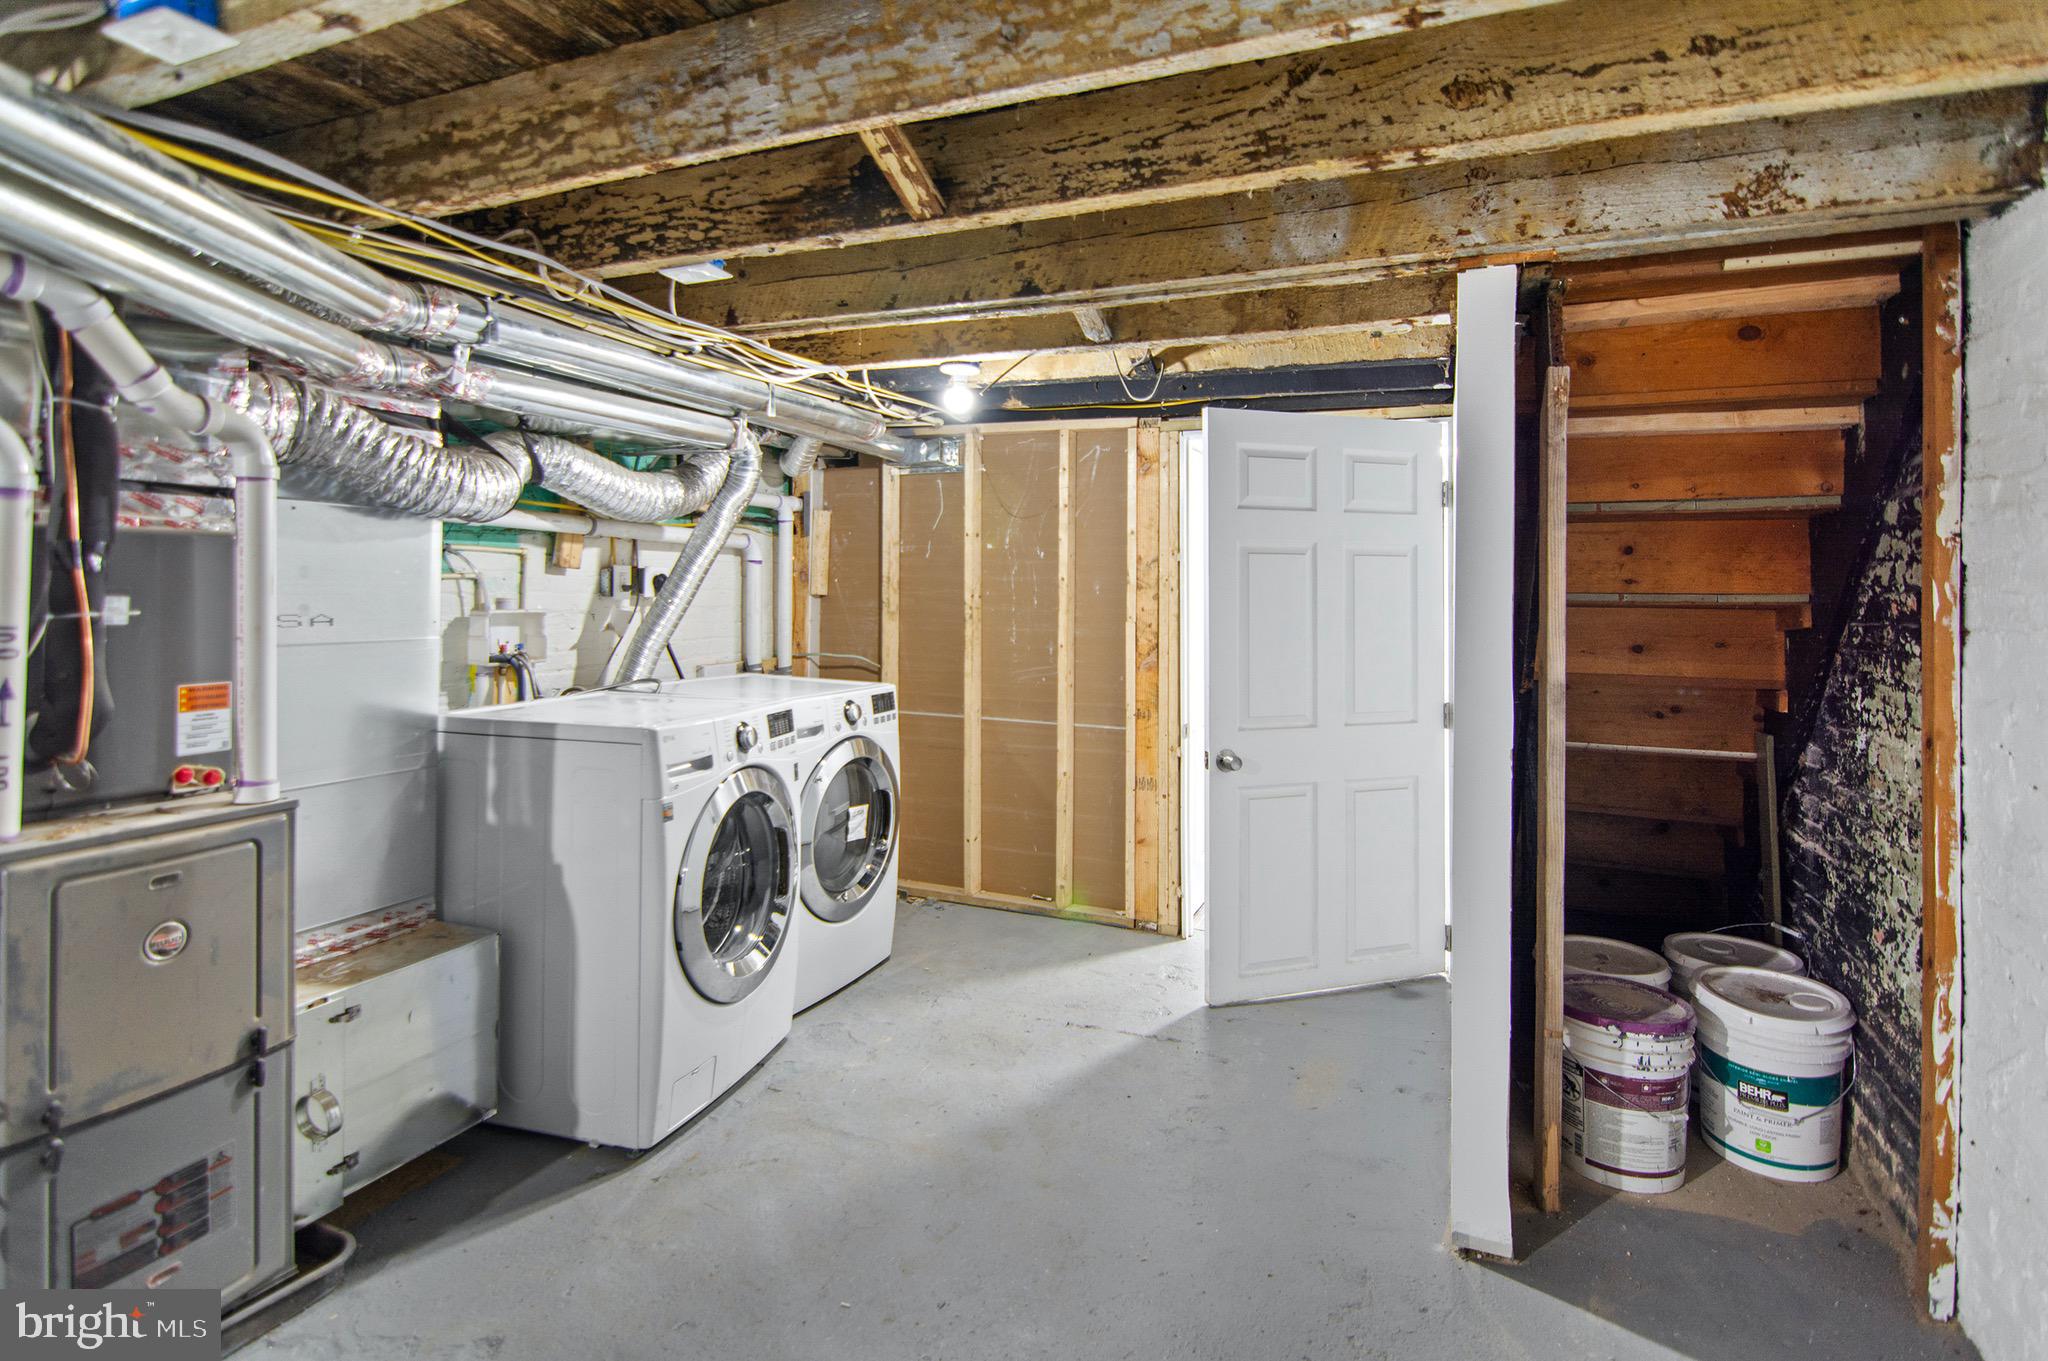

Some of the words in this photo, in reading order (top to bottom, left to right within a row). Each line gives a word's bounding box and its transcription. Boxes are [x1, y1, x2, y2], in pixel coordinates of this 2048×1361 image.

[1739, 1081, 1772, 1101] BEHR
[1733, 1107, 1754, 1120] PAINT
[1763, 1118, 1792, 1128] PRIMER
